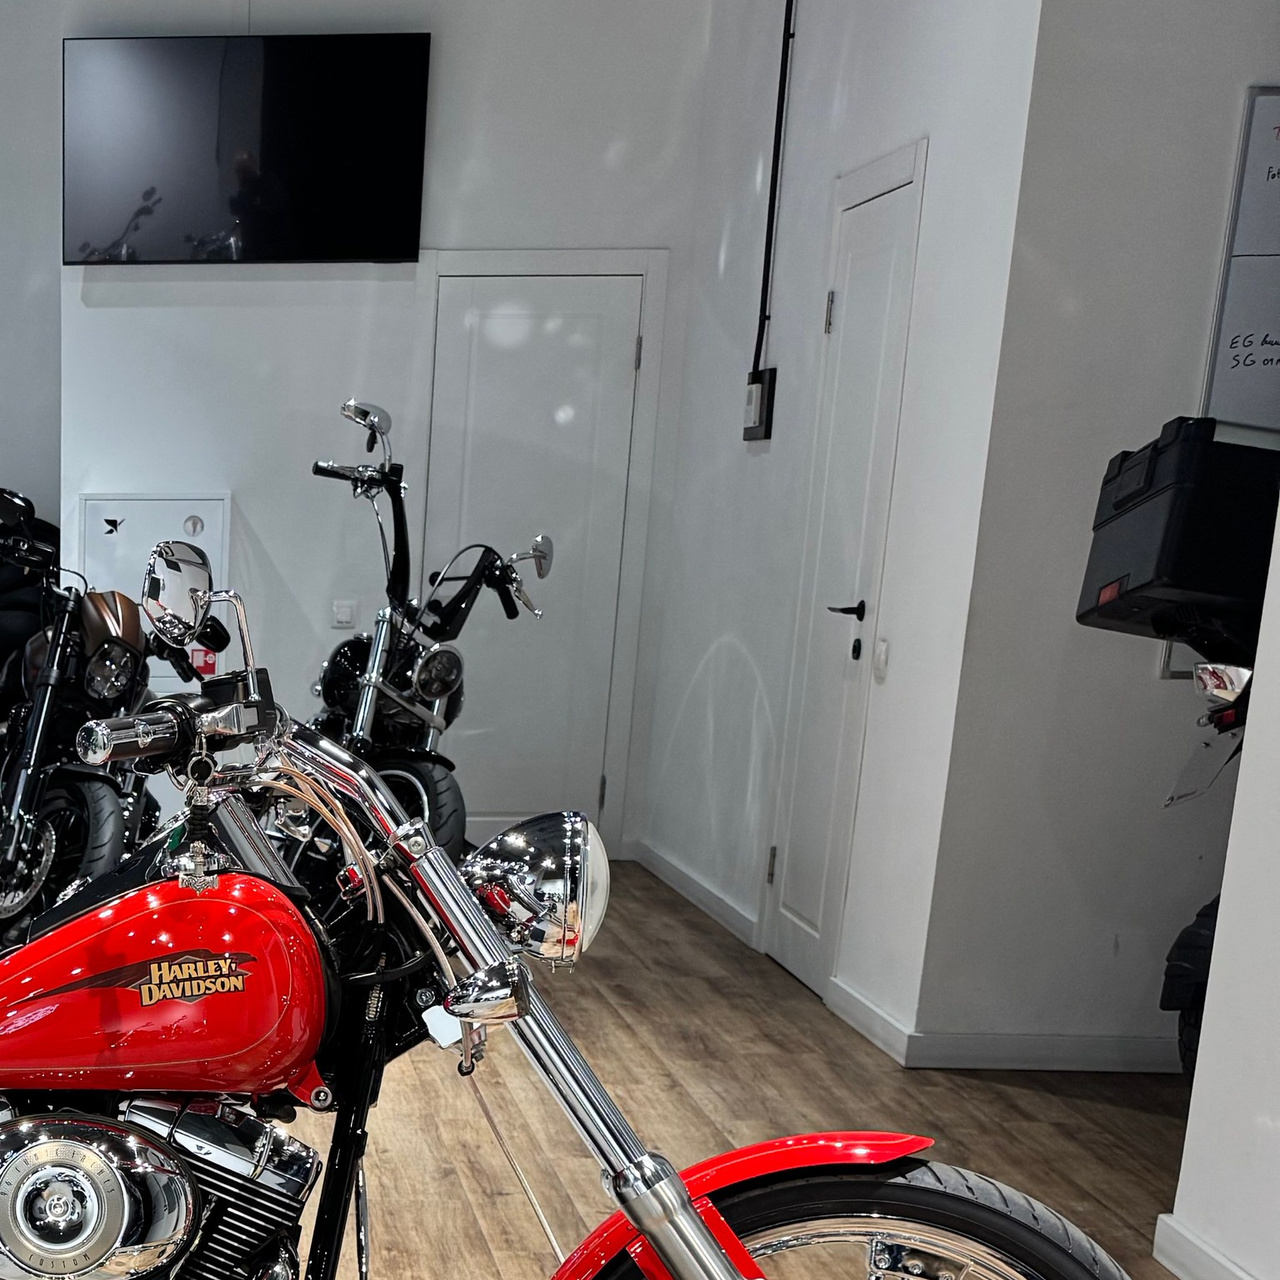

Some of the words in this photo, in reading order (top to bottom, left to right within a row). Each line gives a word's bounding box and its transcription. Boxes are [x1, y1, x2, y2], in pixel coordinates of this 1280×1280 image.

[1229, 333, 1255, 349] EG
[1230, 353, 1256, 369] SG
[140, 975, 244, 1006] DAVIDSON
[28, 1253, 91, 1269] CUSTOM
